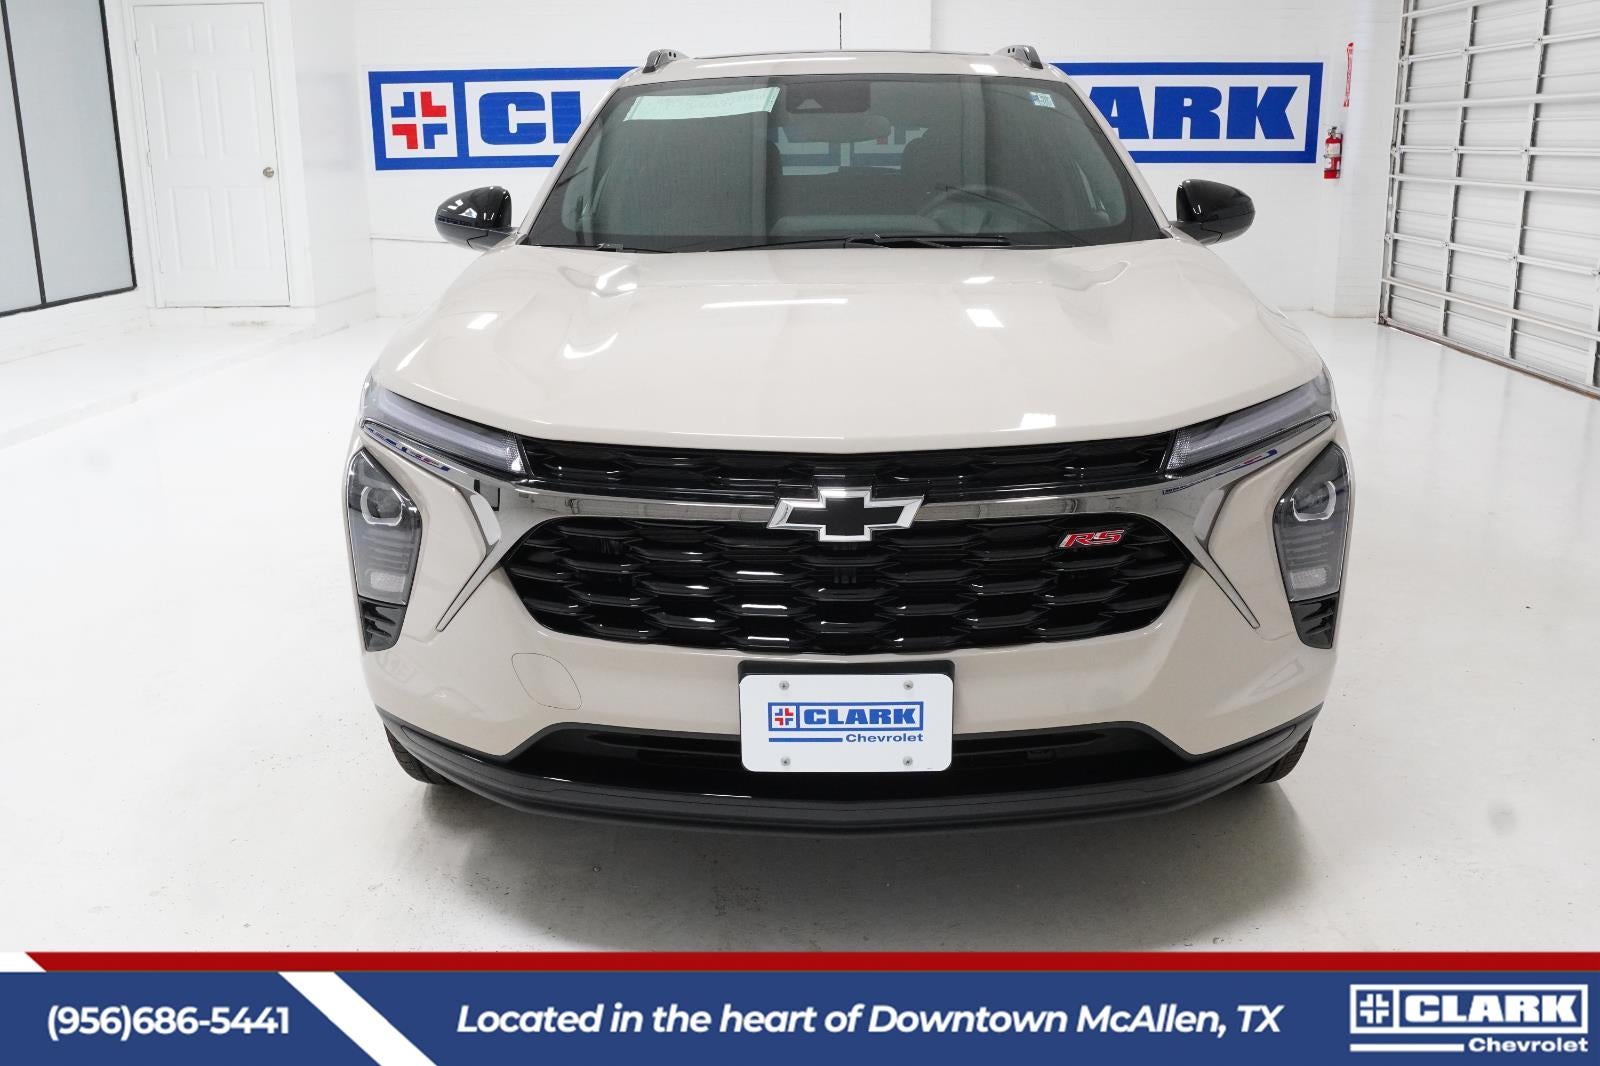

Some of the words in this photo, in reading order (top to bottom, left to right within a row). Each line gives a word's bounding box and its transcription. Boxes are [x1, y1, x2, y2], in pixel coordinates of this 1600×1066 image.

[1089, 86, 1298, 140] ARK
[1059, 529, 1125, 548] RS
[803, 708, 916, 725] CLARK
[845, 733, 924, 743] Chevrolet
